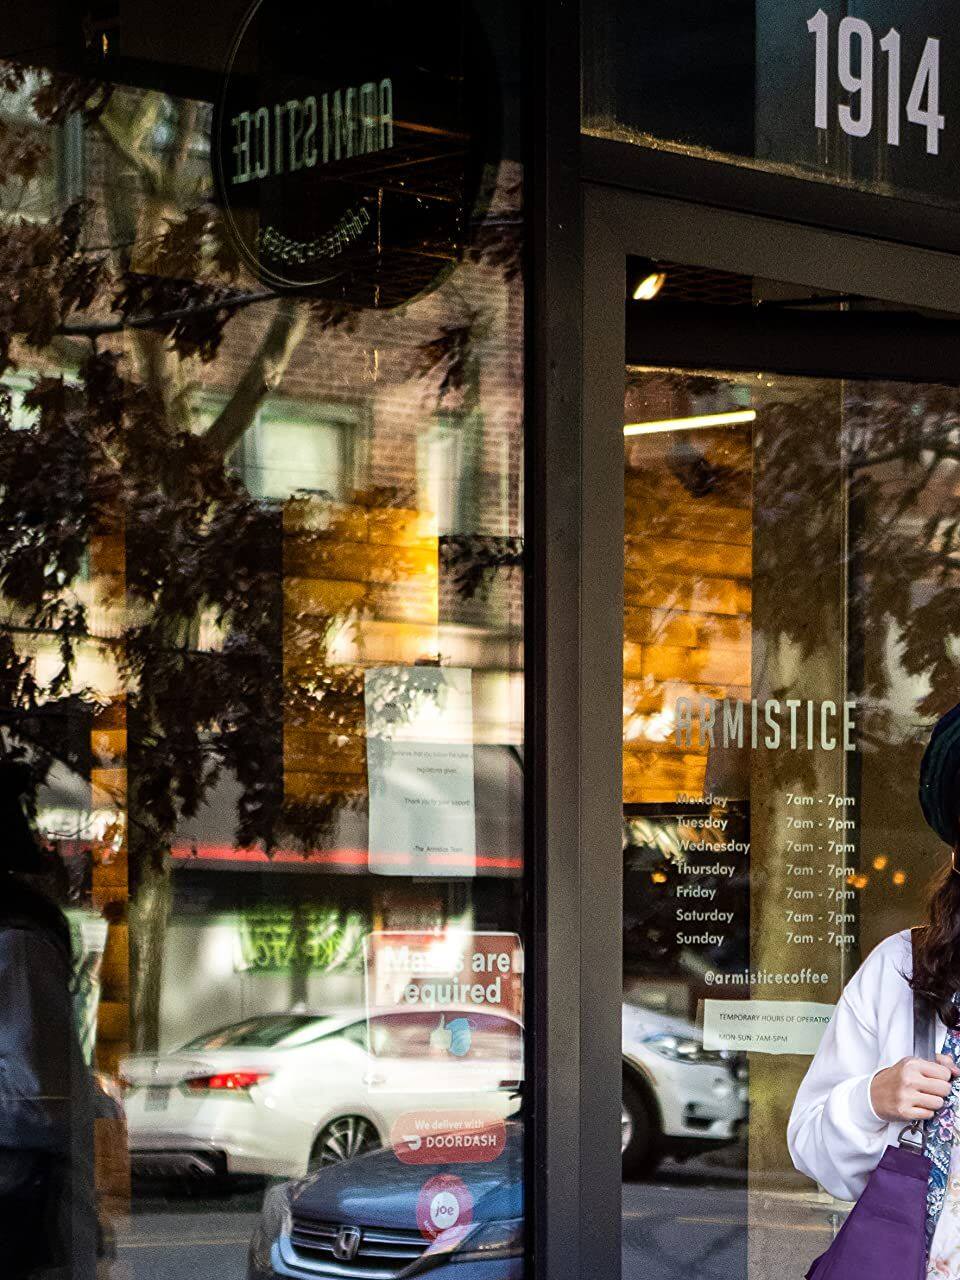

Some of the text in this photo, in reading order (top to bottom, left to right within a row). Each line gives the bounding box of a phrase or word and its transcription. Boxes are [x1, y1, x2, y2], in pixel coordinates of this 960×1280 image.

[806, 8, 946, 156] 1914
[675, 696, 857, 751] ARMISTICE
[675, 793, 728, 808] Monday
[785, 793, 815, 805] 7am
[827, 794, 856, 808] 7pm
[676, 816, 728, 832] Tuesday
[785, 817, 815, 829] 7am
[827, 818, 856, 832] 7pm
[676, 840, 751, 853] Wednesday
[785, 841, 815, 853] 7am
[827, 841, 856, 855] 7pm
[677, 863, 736, 878] Thursday
[785, 864, 815, 876] 7am
[827, 864, 856, 878] 7pm
[676, 885, 717, 901] Friday
[785, 888, 815, 900] 7am
[827, 888, 856, 902] 7pm
[676, 909, 734, 924] Saturday
[785, 911, 815, 923] 7am
[827, 911, 856, 925] 7pm
[676, 932, 725, 947] Sunday
[785, 933, 815, 944] 7am
[827, 933, 856, 947] 7pm
[383, 946, 511, 974] Mas are
[704, 969, 829, 986] @armisticecoffee
[392, 977, 502, 1009] required
[719, 1013, 760, 1021] TEMPORARY
[796, 1016, 832, 1024] OPERATIO
[415, 1118, 486, 1131] We deliver with
[426, 1135, 498, 1148] DOORDASH
[434, 1201, 455, 1217] joe
